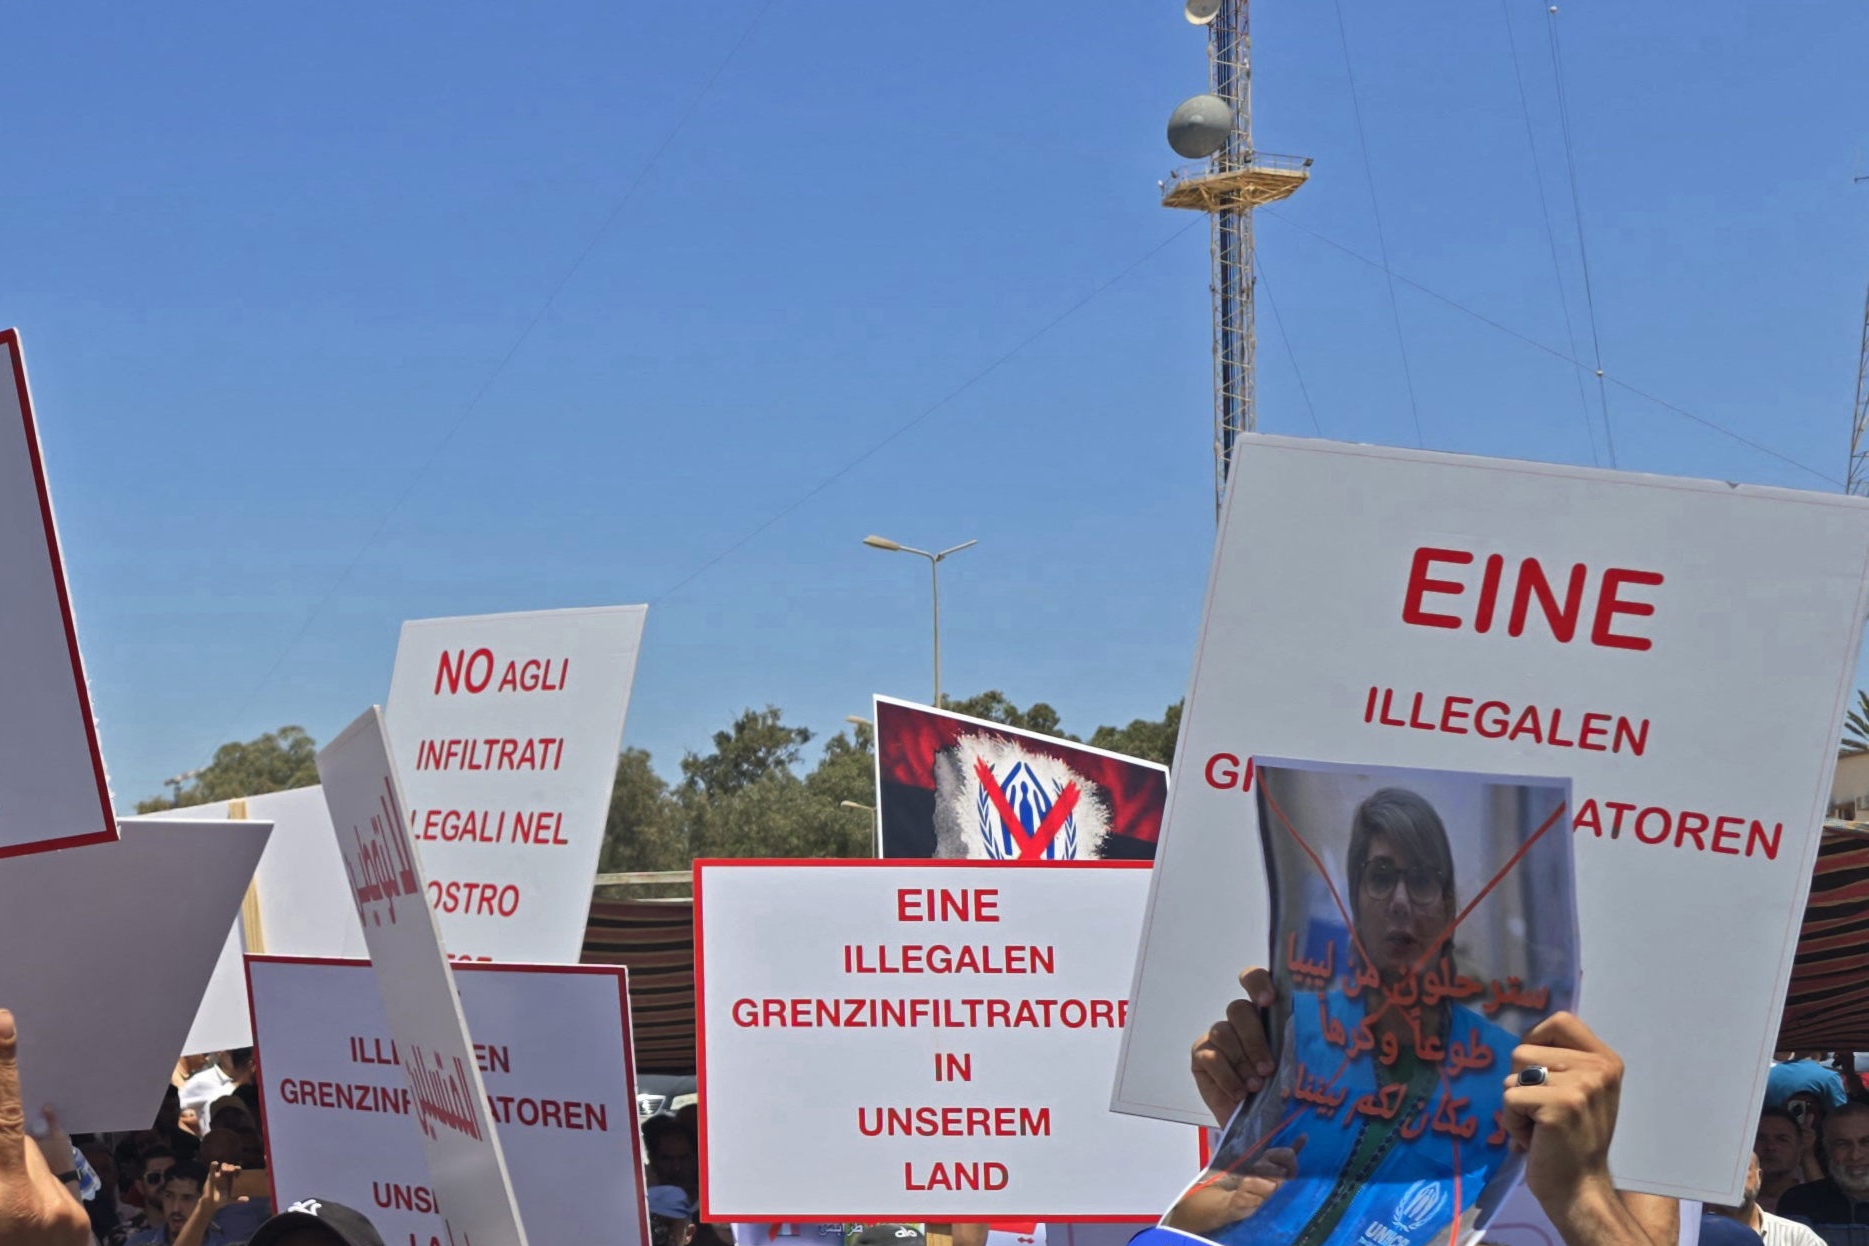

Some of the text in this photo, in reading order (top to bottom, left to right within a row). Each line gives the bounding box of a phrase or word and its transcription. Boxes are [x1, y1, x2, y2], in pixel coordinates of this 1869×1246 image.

[1402, 546, 1665, 652] EINE
[434, 647, 569, 695] NO AGLI
[1363, 685, 1650, 757] ILLEGALEN
[416, 738, 564, 771] INFILTRATI
[380, 775, 417, 896] لا
[511, 812, 568, 845] NEL
[428, 880, 520, 918] OSTRO
[897, 888, 1000, 922] EINE
[844, 944, 1055, 974] ILLEGALEN
[1288, 931, 1334, 987] ليبيا
[732, 998, 1129, 1028] GRENZINFILTRATOR
[935, 1053, 972, 1082] IN
[858, 1107, 1050, 1137] UNSEREM
[1343, 1083, 1407, 1128] لكم
[1400, 1091, 1477, 1139] مكان
[904, 1161, 1009, 1192] LAND
